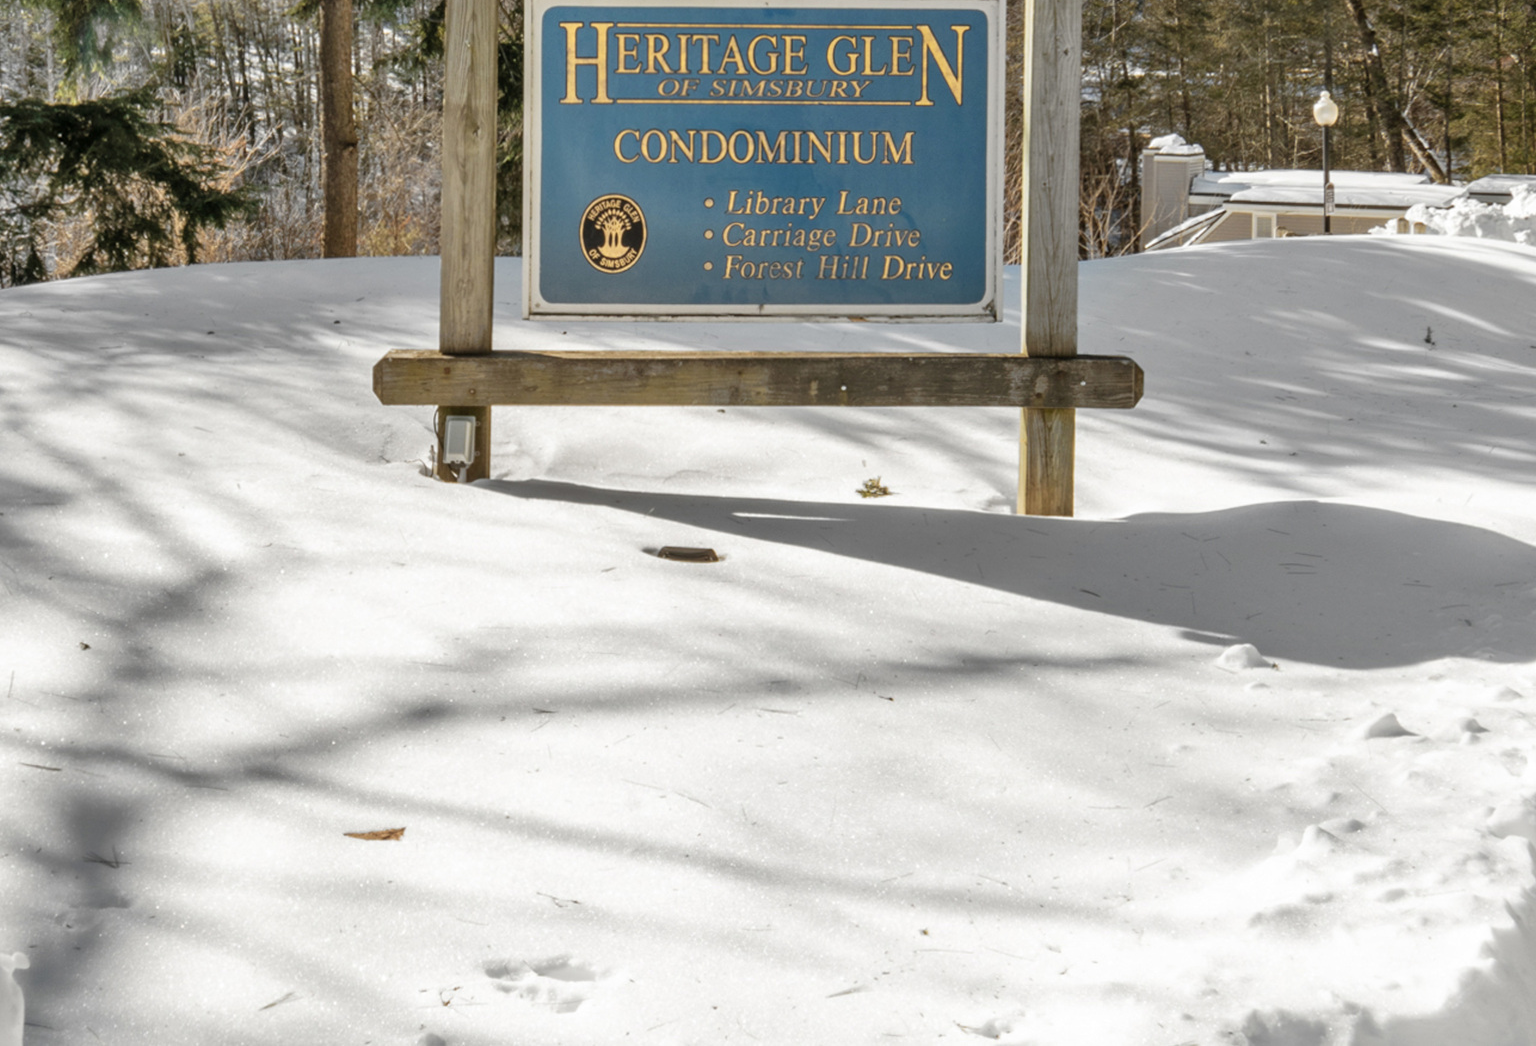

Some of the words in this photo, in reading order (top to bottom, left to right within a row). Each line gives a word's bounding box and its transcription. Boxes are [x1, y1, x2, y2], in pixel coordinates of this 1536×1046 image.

[559, 22, 809, 105] HERITAGE
[826, 24, 971, 106] GLEN
[657, 79, 700, 97] OF
[709, 80, 873, 98] SIMSBURY
[613, 129, 915, 165] CONDOMINIUM
[588, 200, 621, 221] HERITAGE
[624, 204, 641, 223] GLEN
[725, 189, 826, 220] Library
[836, 190, 902, 215] Lane
[722, 222, 836, 252] Carriage
[849, 222, 921, 248] Drive
[589, 249, 600, 260] OF
[600, 249, 638, 269] SIMSBURY
[722, 255, 804, 280] Forest
[818, 255, 869, 280] Hill
[881, 255, 953, 281] Drive
